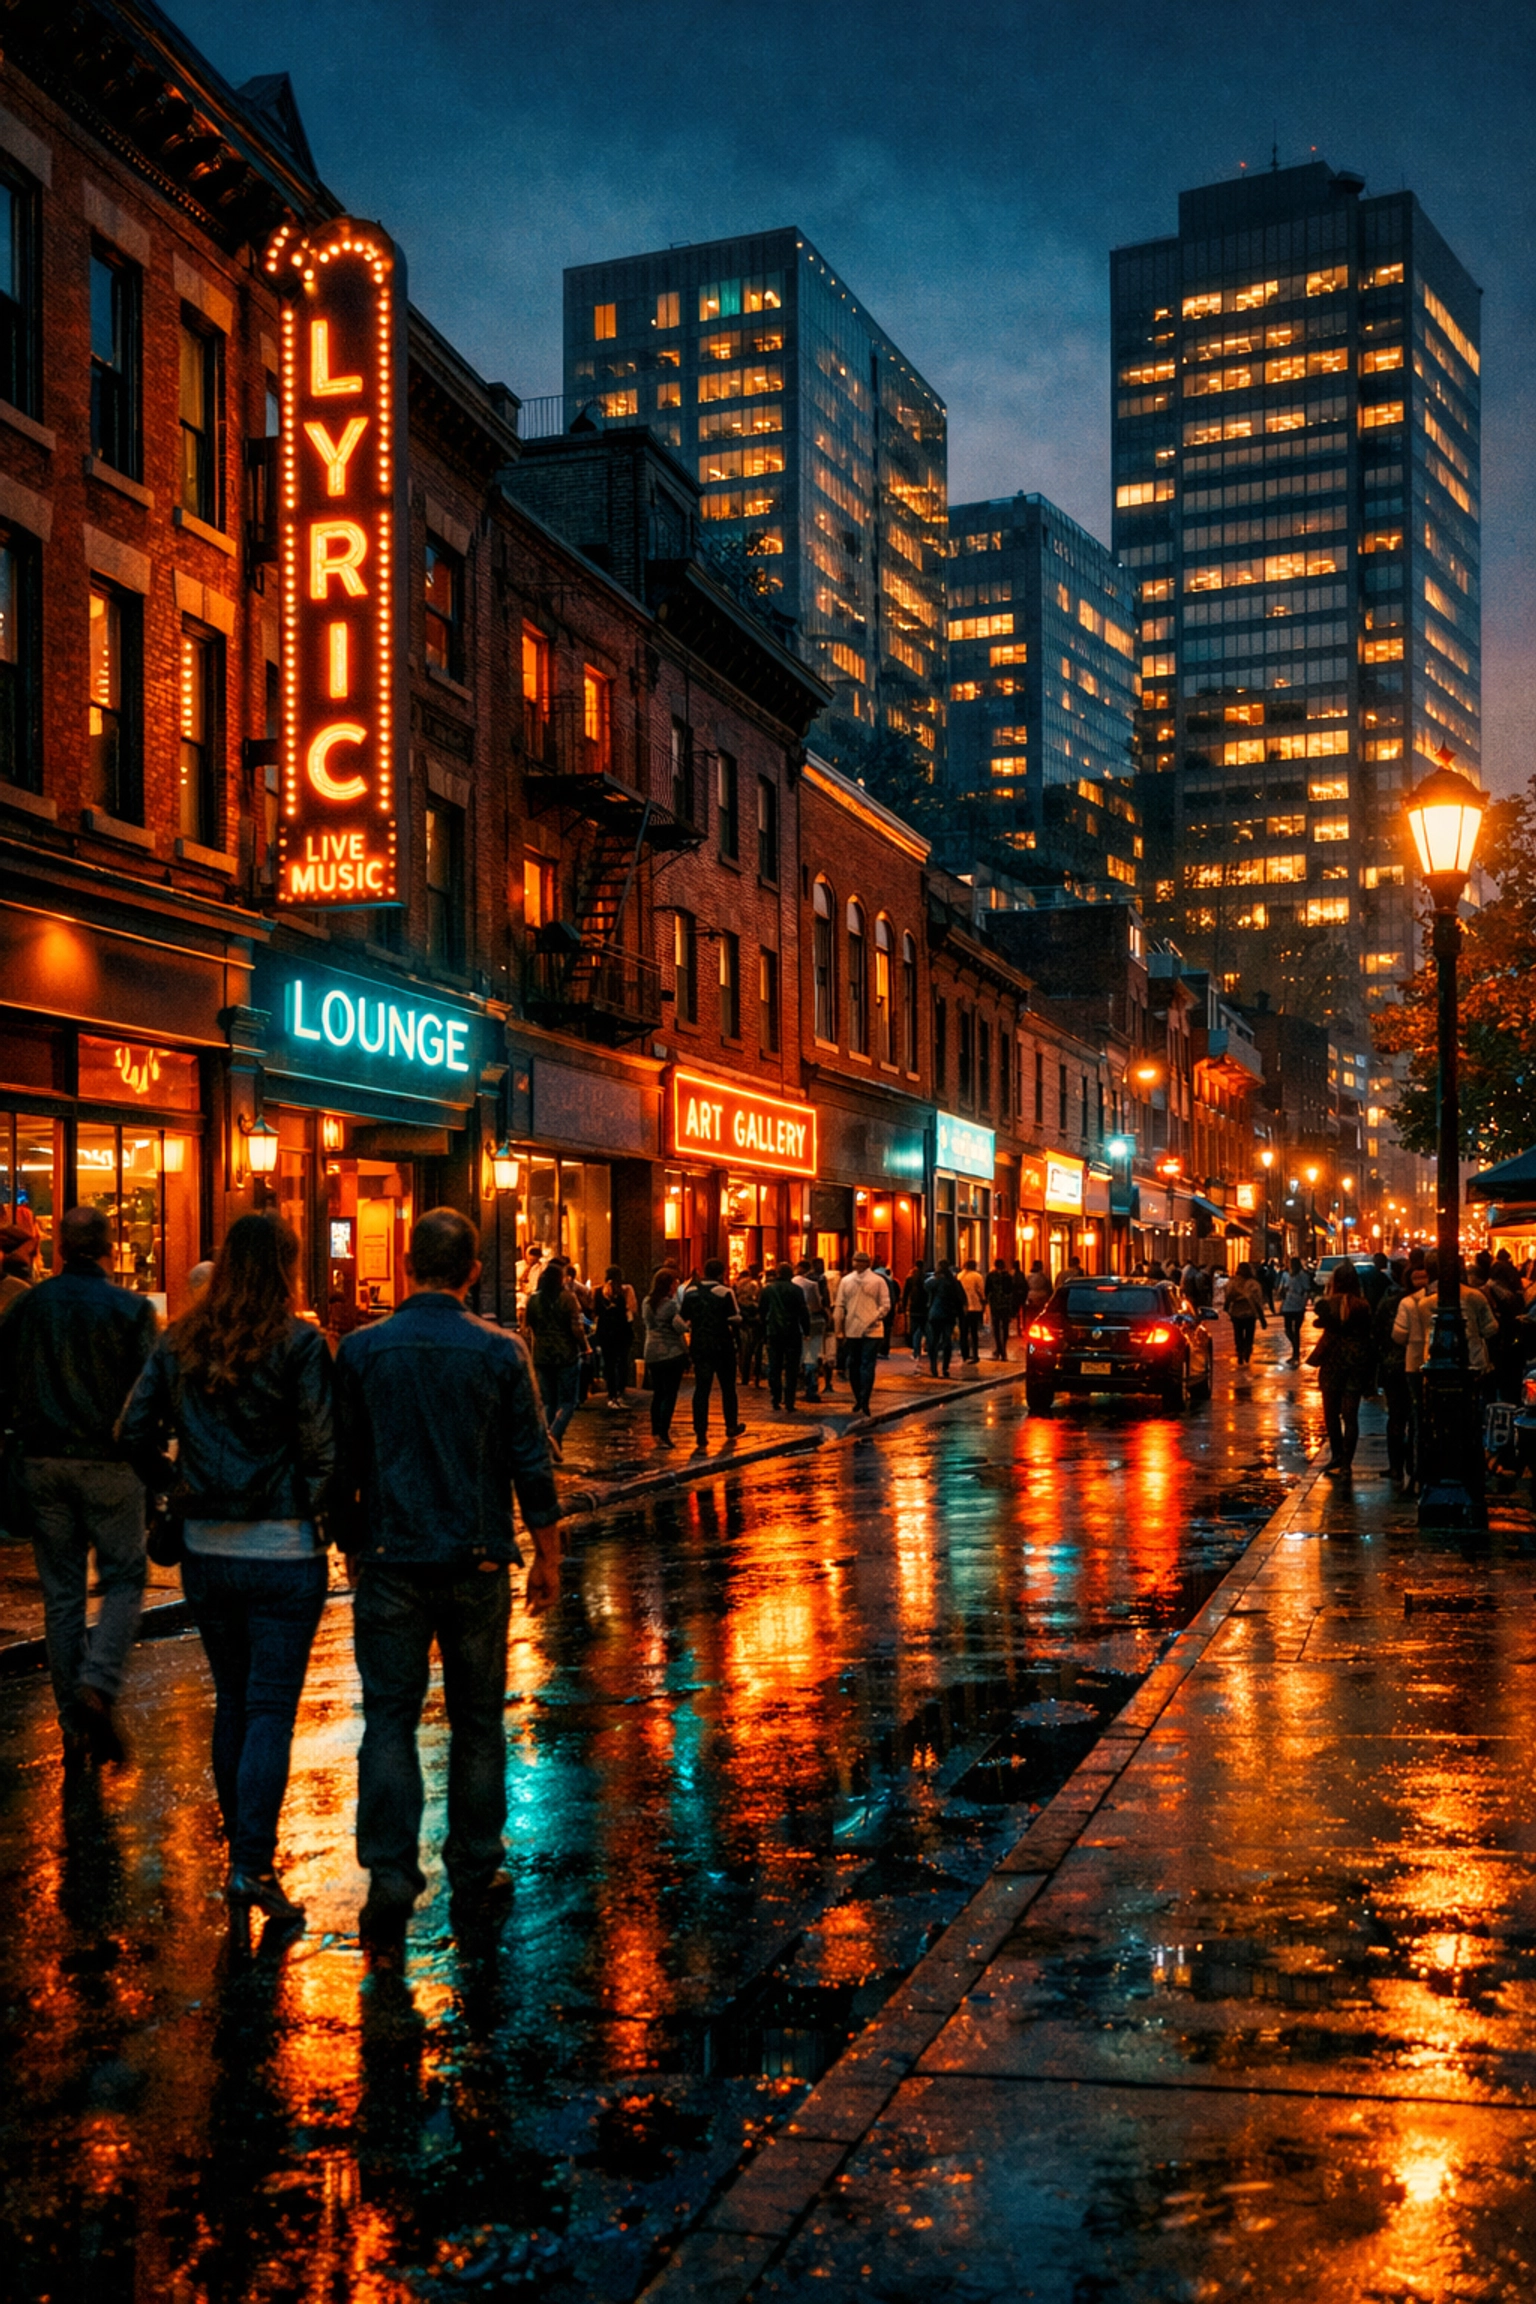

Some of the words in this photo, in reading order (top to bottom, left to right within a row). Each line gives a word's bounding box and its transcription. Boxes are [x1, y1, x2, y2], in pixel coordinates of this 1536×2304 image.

[303, 319, 369, 801] LYRIC
[291, 861, 384, 895] MUSIC
[306, 834, 365, 862] LIVE
[293, 979, 470, 1073] LOUNGE
[685, 1097, 723, 1142] ART
[733, 1110, 807, 1159] GALLERY
